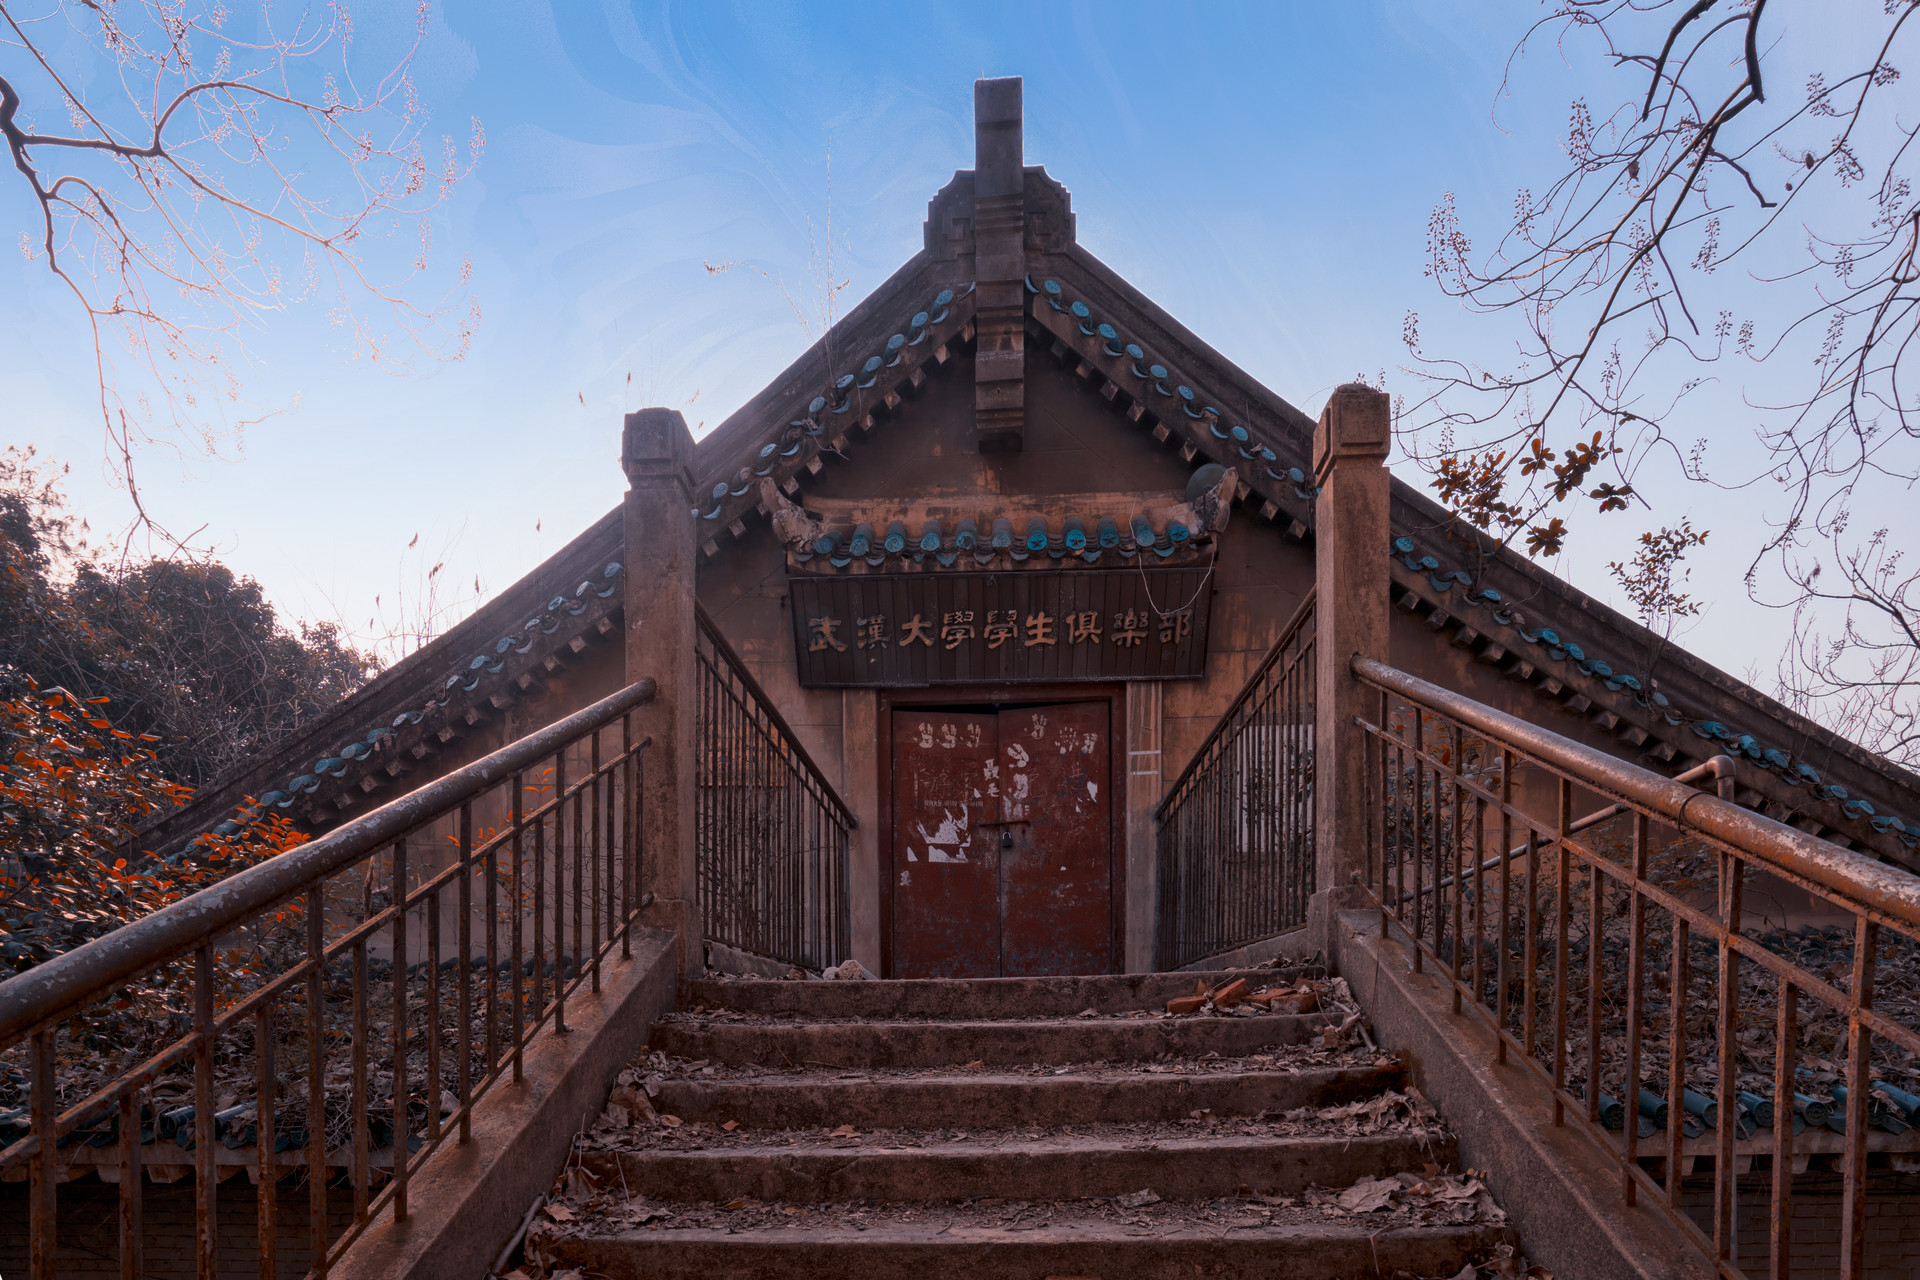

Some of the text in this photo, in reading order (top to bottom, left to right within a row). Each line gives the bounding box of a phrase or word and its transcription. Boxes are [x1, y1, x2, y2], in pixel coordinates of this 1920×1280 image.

[808, 609, 1192, 653] 武漢大學學生俱樂部
